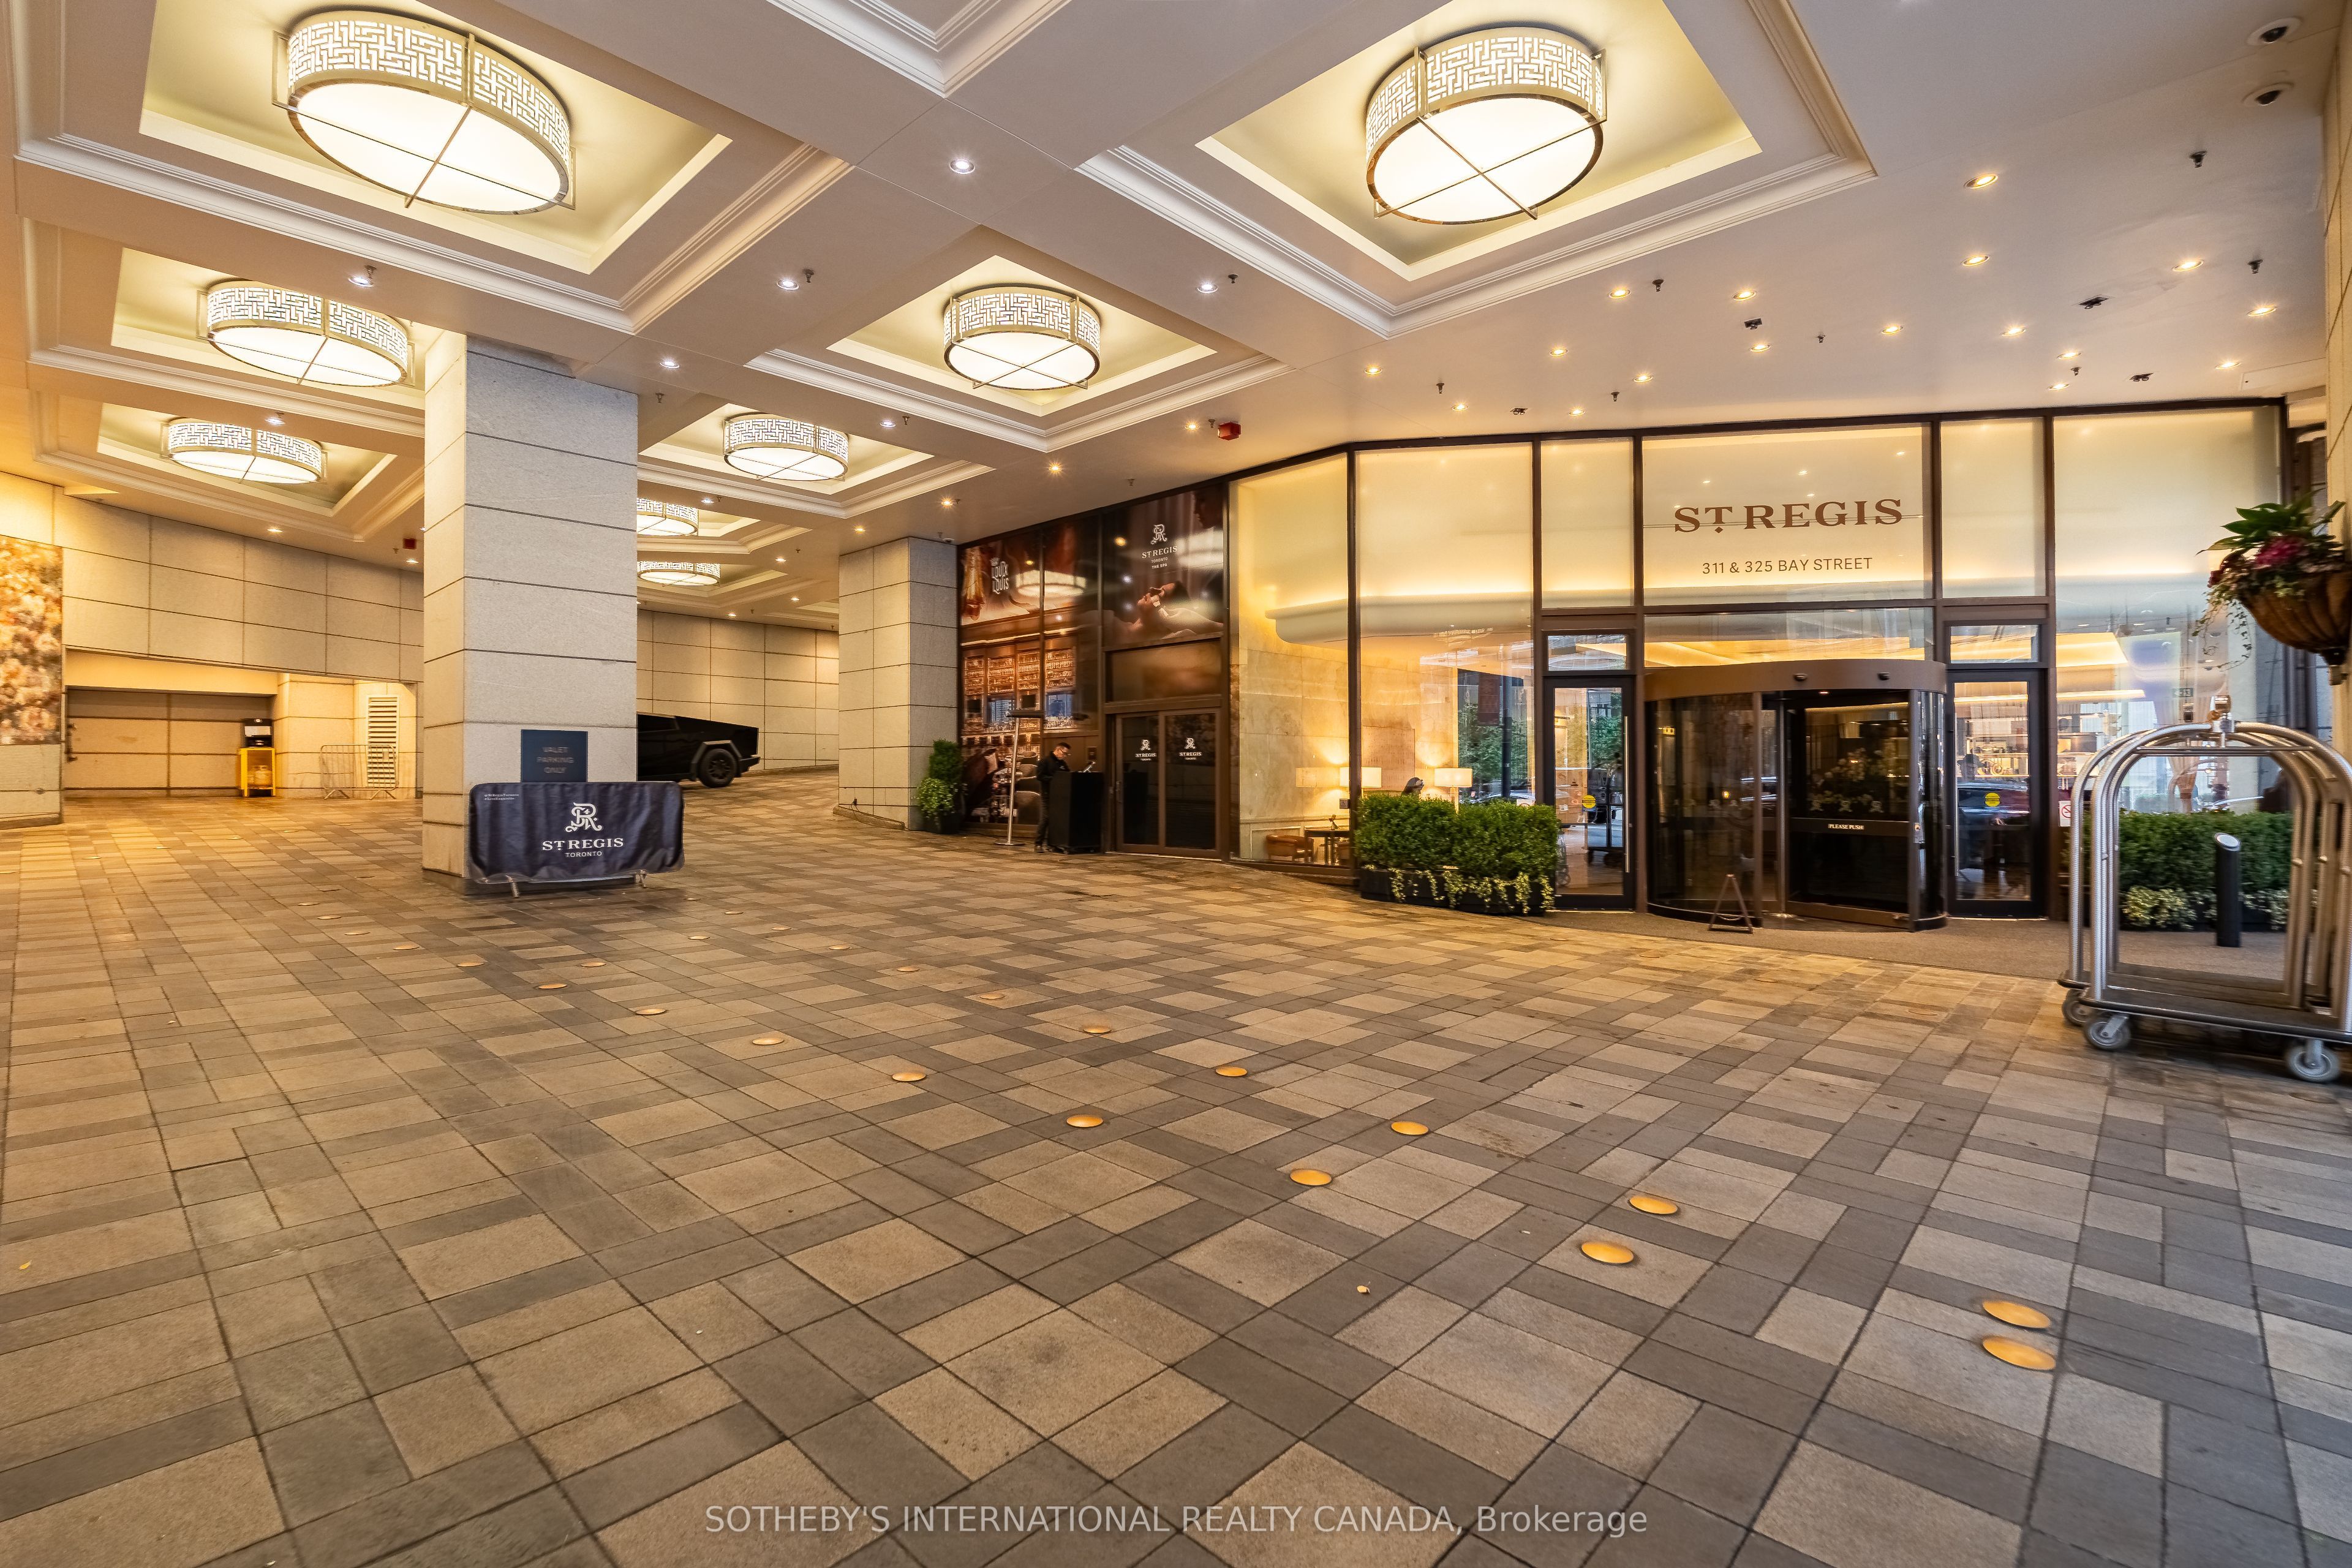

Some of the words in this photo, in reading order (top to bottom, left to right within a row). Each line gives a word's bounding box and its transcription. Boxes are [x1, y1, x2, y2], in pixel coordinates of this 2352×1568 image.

[1743, 499, 1902, 530] REGIS
[1153, 545, 1178, 557] REGIS
[1702, 562, 1724, 575] 311
[1729, 562, 1740, 573] &
[1744, 560, 1773, 573] 325
[1778, 559, 1809, 571] BAY
[1813, 557, 1872, 570] STREET
[992, 578, 1009, 594] LOUIS
[568, 838, 624, 849] REGIS
